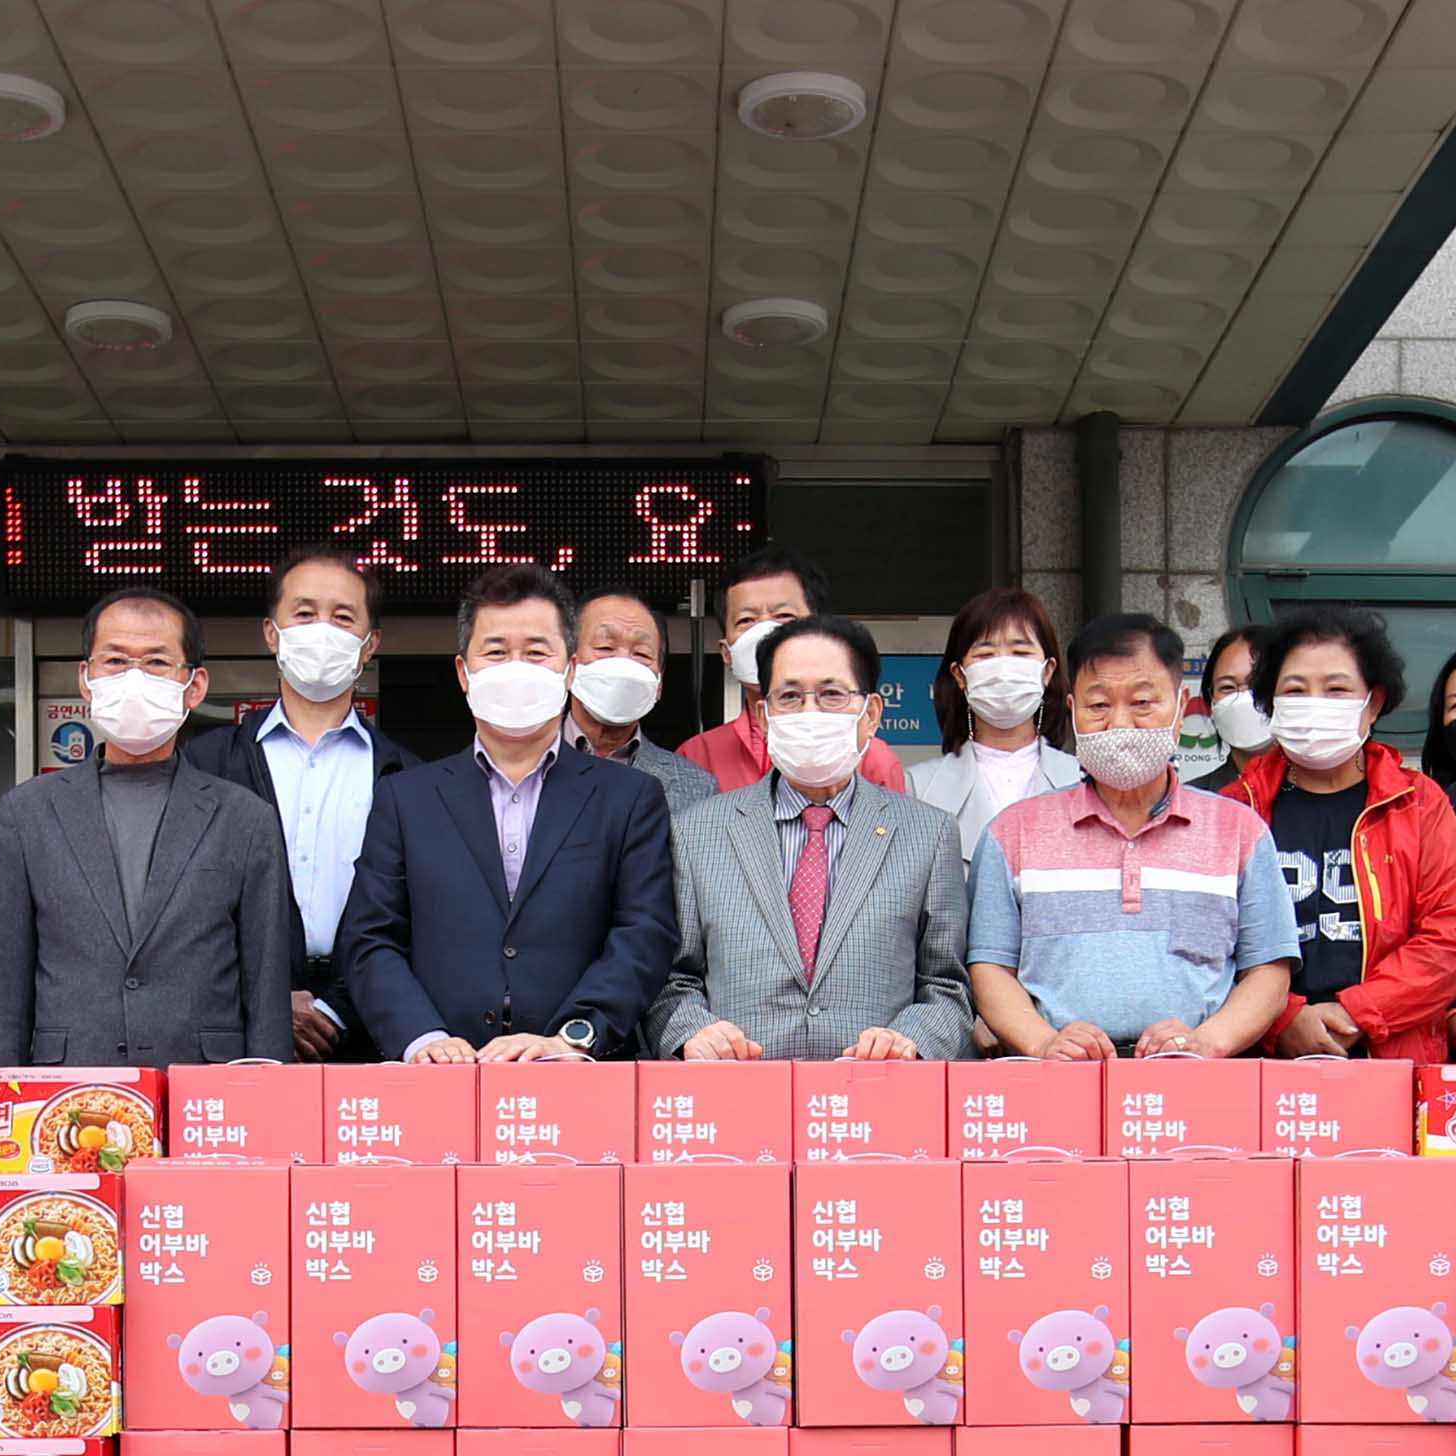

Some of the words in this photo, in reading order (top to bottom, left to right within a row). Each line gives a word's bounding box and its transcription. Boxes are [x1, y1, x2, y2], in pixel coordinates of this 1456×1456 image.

[67, 478, 279, 574] 받는
[324, 478, 574, 574] 것도,
[184, 1099, 223, 1121] 신협
[338, 1098, 378, 1120] 신협
[496, 1096, 536, 1119] 신협
[653, 1096, 693, 1118] 신협
[808, 1095, 848, 1117] 신협
[964, 1095, 1004, 1117] 신협
[1122, 1093, 1163, 1115] 신협
[1276, 1093, 1316, 1115] 신협
[184, 1126, 248, 1147] 어부바
[338, 1125, 402, 1146] 어부바
[496, 1124, 560, 1146] 어부바
[653, 1123, 717, 1144] 어부바
[808, 1122, 872, 1143] 어부바
[963, 1122, 1028, 1143] 어부바
[1122, 1120, 1186, 1142] 어부바
[1276, 1120, 1340, 1141] 어부바
[140, 1205, 183, 1228] 신협
[306, 1201, 350, 1225] 신협
[472, 1202, 515, 1225] 신협
[641, 1202, 684, 1225] 신협
[813, 1200, 856, 1224] 신협
[980, 1199, 1023, 1223] 신협
[1146, 1196, 1189, 1220] 신협
[1317, 1195, 1361, 1219] 신협
[140, 1234, 208, 1256] 어부바
[306, 1231, 375, 1253] 어부바
[472, 1231, 541, 1253] 어부바
[641, 1230, 710, 1253] 어부바
[813, 1229, 882, 1252] 어부바
[980, 1228, 1049, 1251] 어부바
[1146, 1226, 1215, 1249] 어부바
[1317, 1224, 1387, 1248] 어부바
[140, 1262, 184, 1285] 박스
[306, 1259, 351, 1282] 박스
[472, 1259, 517, 1282] 박스
[642, 1259, 687, 1282] 박스
[813, 1258, 858, 1280] 박스
[980, 1257, 1025, 1280] 박스
[1146, 1255, 1191, 1277] 박스
[1317, 1253, 1363, 1276] 박스
